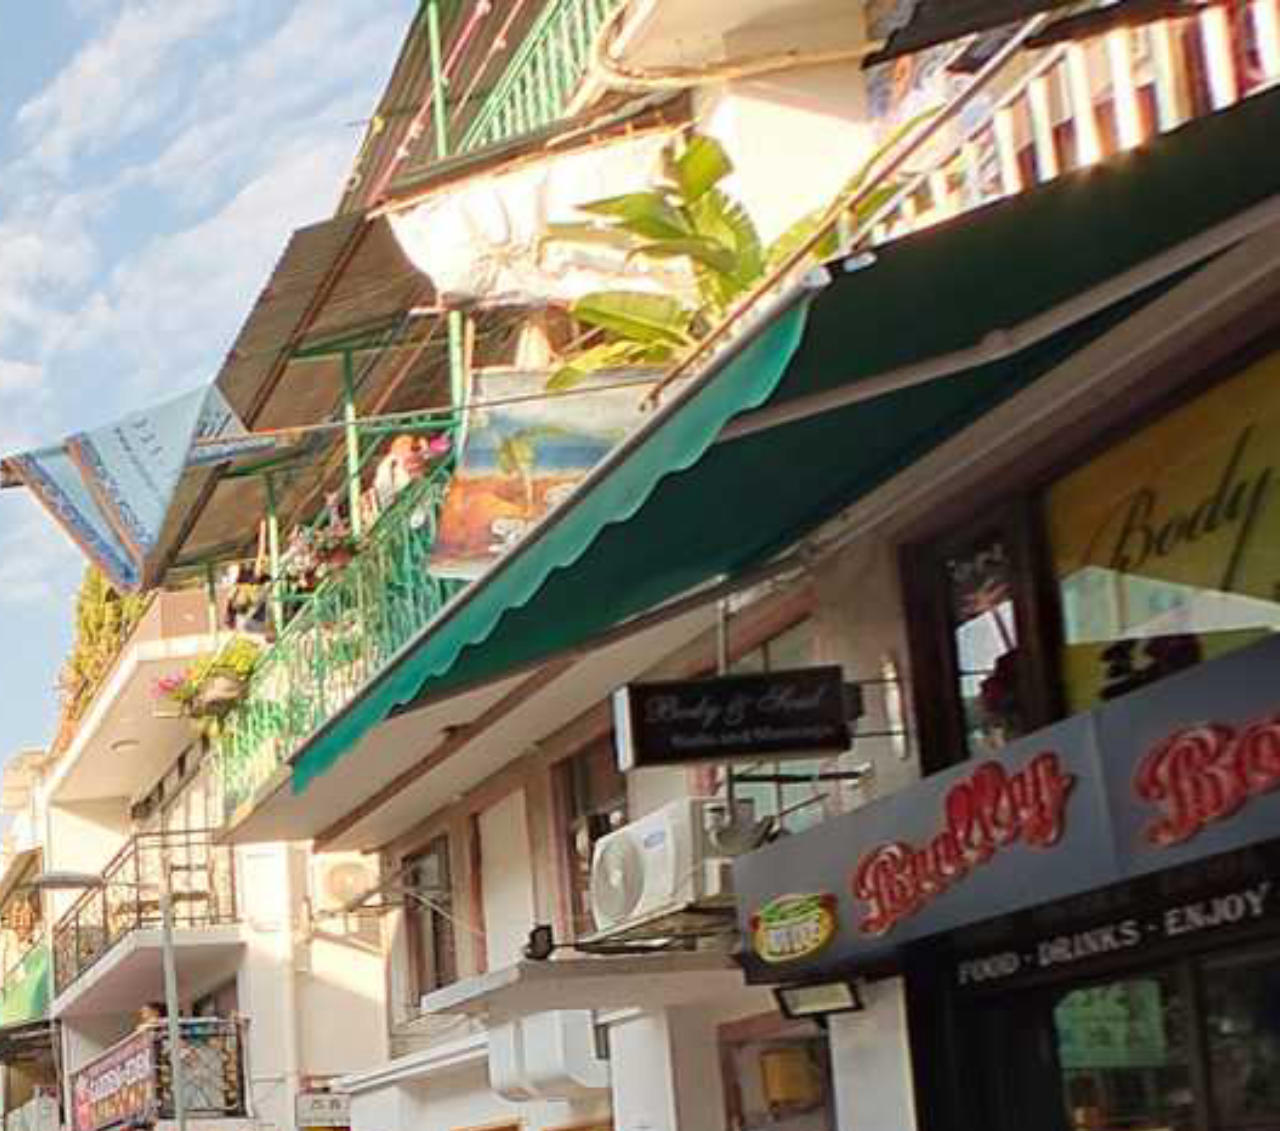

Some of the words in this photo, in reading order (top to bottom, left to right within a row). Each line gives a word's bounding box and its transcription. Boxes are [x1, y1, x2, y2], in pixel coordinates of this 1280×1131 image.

[1081, 424, 1272, 593] Body
[957, 950, 1022, 985] FOOD
[1037, 919, 1141, 967] DRINKS
[1163, 882, 1272, 936] ENJOY
